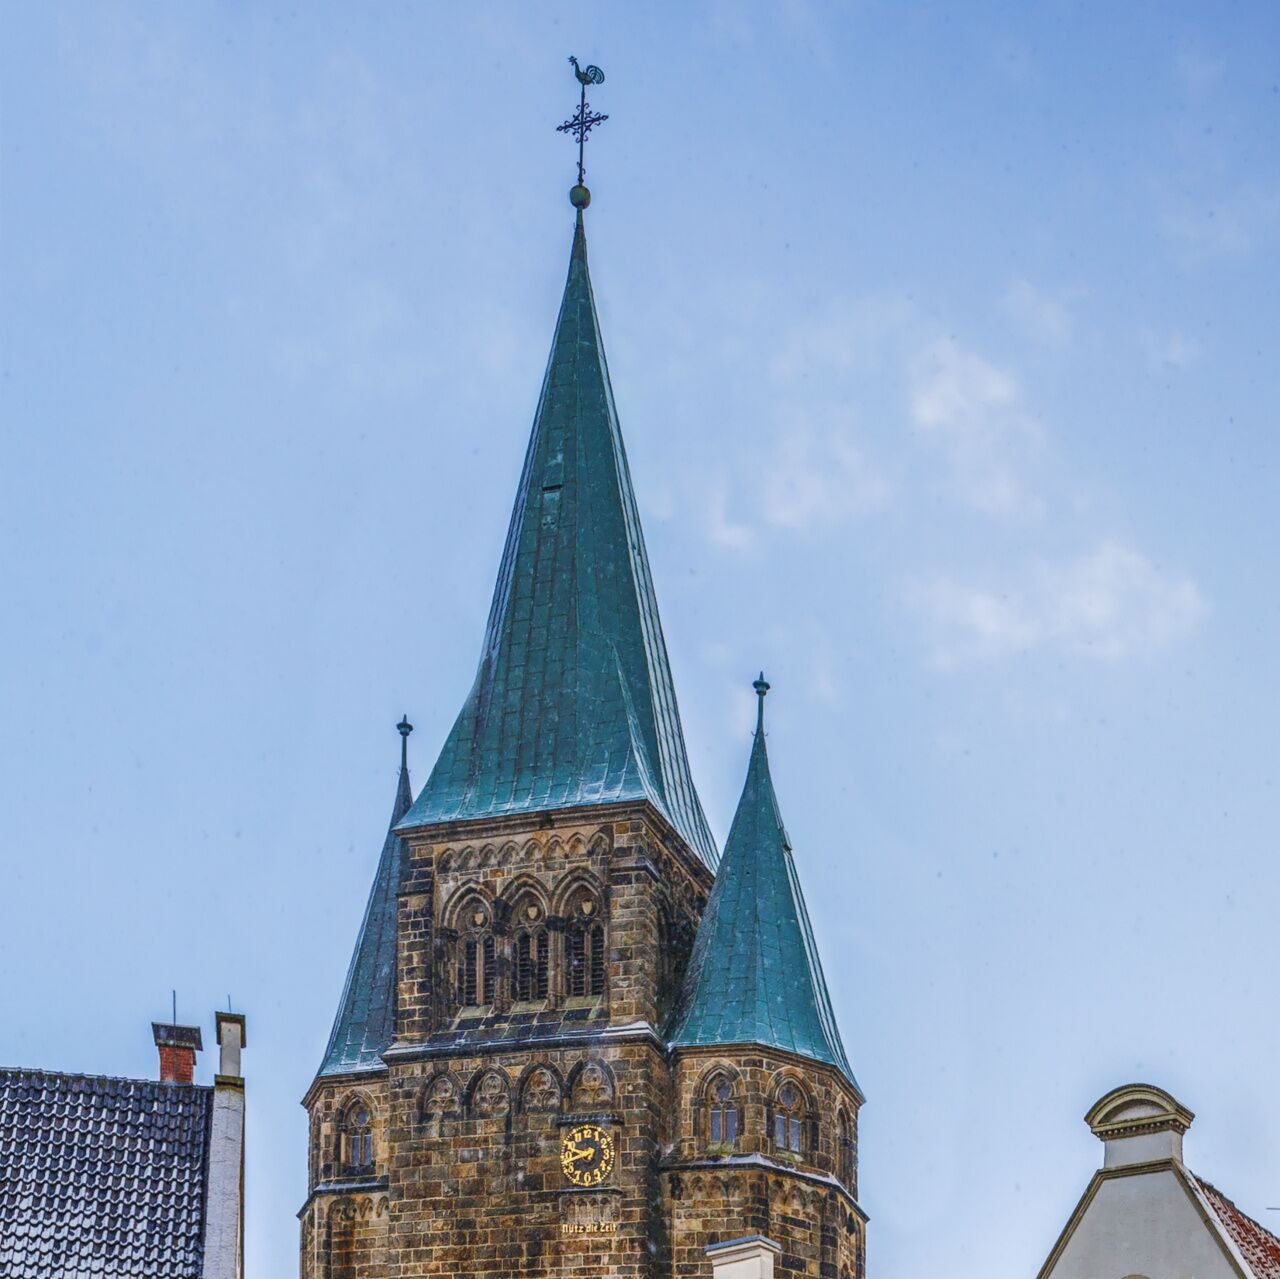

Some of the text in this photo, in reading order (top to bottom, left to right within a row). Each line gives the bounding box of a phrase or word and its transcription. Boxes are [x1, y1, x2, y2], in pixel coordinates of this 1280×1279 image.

[574, 1132, 582, 1142] 11
[583, 1129, 592, 1138] 12
[600, 1138, 607, 1149] 2
[603, 1149, 610, 1160] 3
